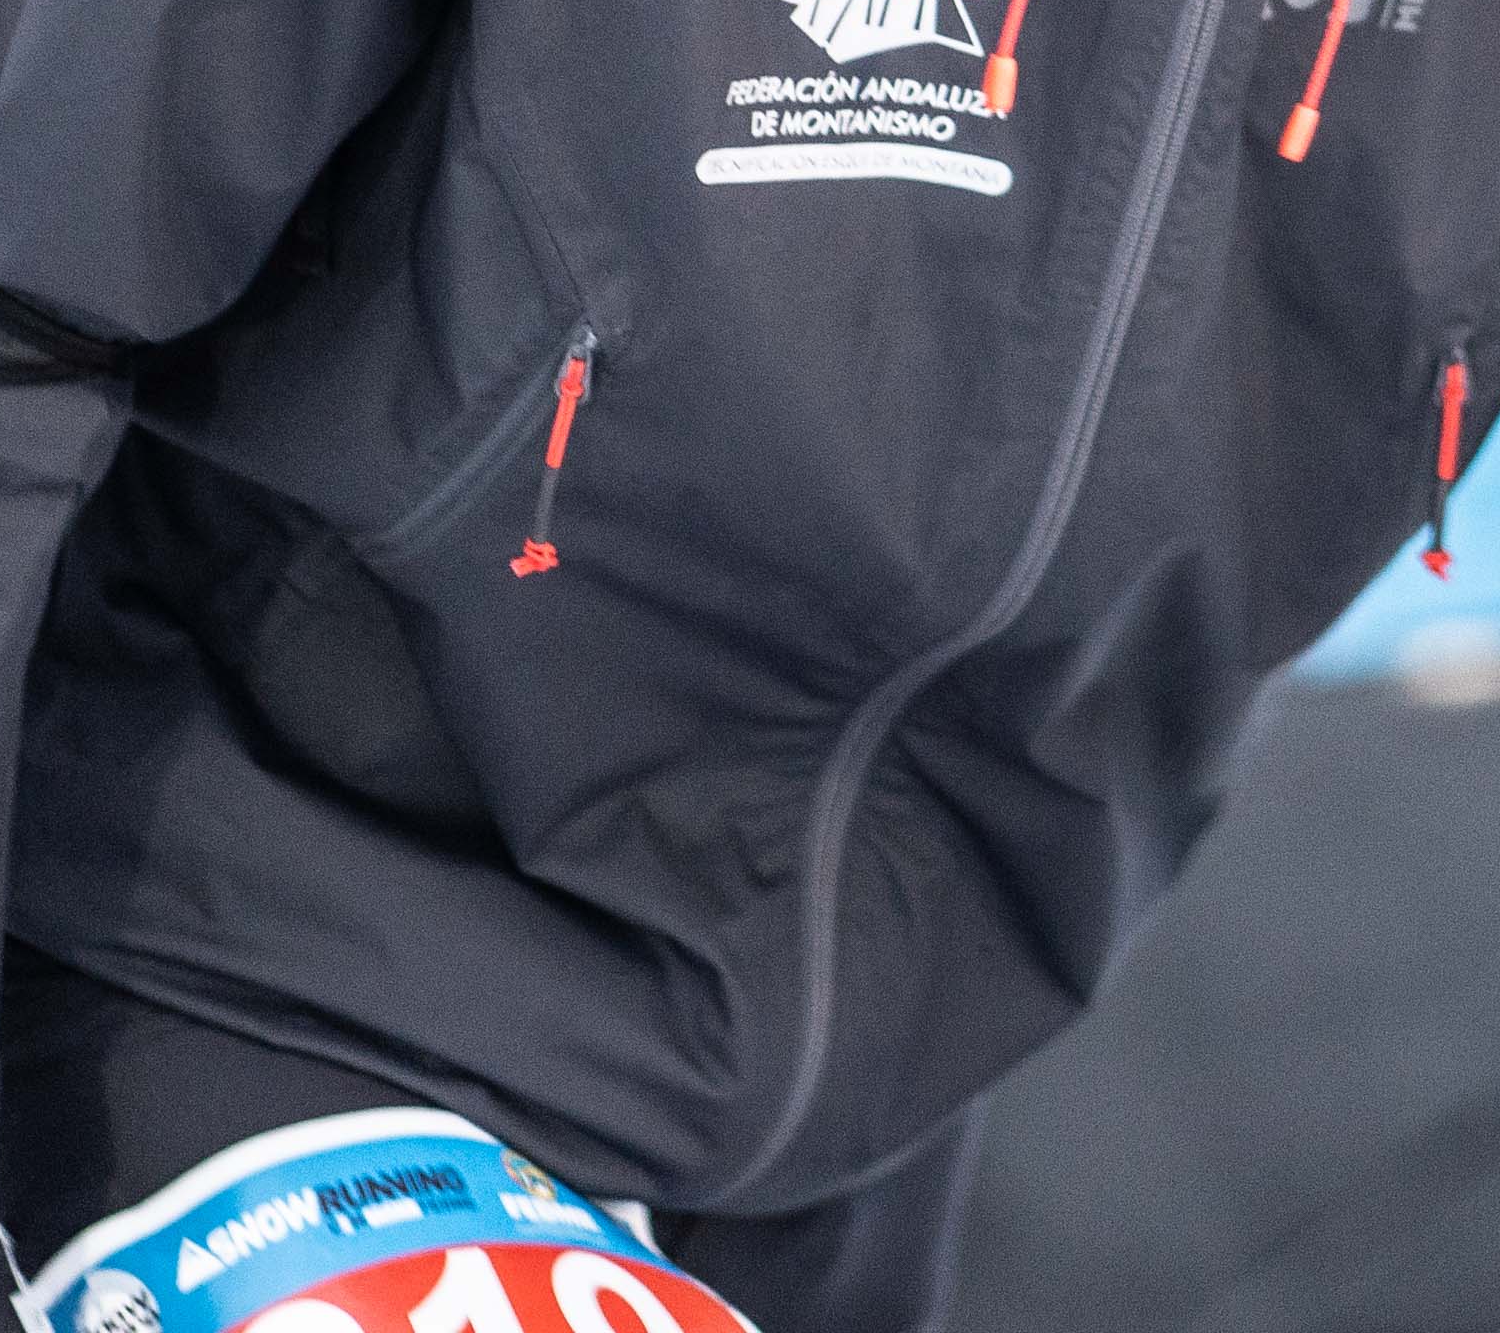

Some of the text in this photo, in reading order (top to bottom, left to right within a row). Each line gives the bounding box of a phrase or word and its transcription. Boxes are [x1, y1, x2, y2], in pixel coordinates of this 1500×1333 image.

[725, 70, 1008, 120] FEDERACIÓN ANDALUZ
[751, 105, 957, 142] DE MONTAÑISMO
